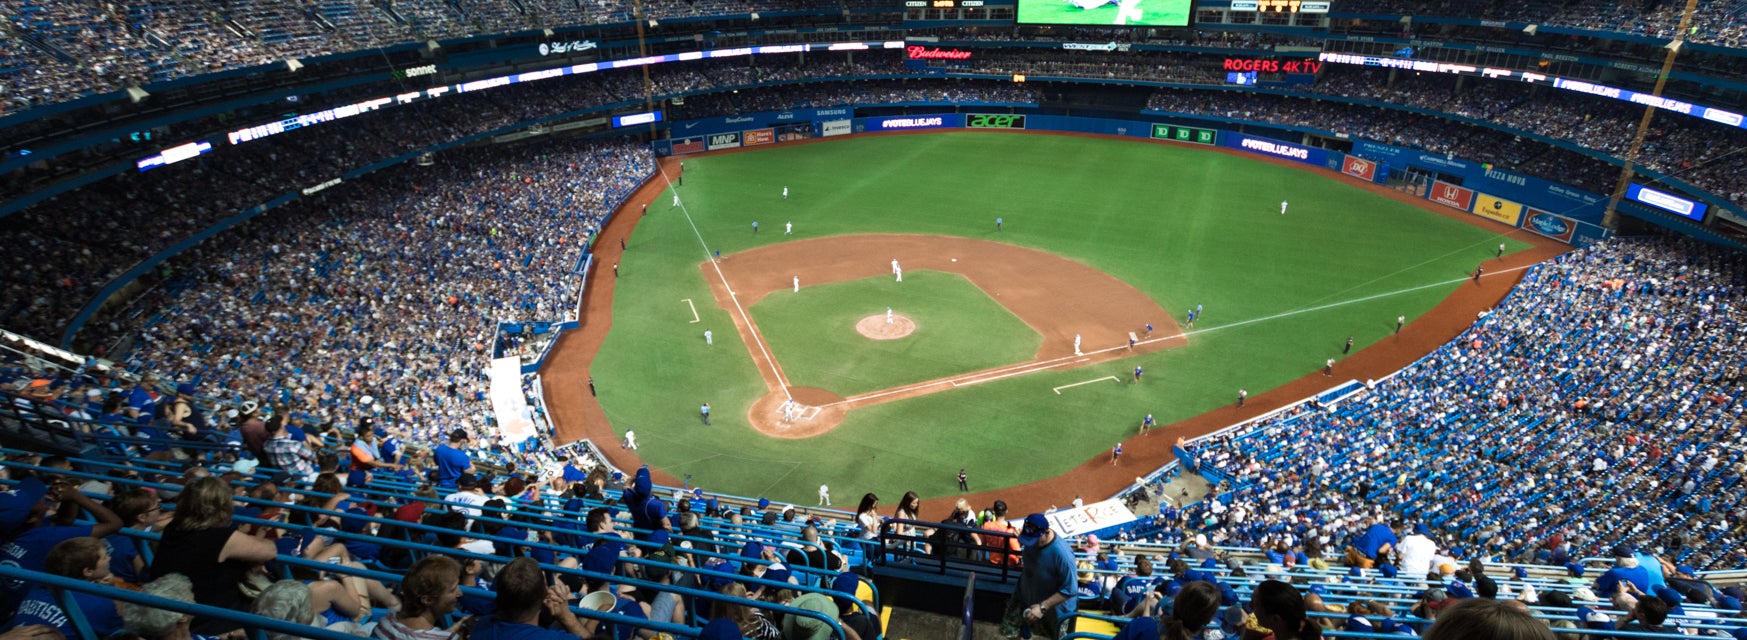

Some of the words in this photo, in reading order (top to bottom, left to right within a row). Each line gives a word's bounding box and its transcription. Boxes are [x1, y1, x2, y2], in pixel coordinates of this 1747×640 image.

[907, 45, 972, 59] Budweiser
[405, 64, 437, 77] sonnet
[1223, 58, 1279, 72] ROGERS
[1282, 61, 1300, 73] 4K
[1302, 61, 1322, 74] TV
[816, 108, 847, 116] SAMSUNG
[882, 117, 942, 128] #VOTEBLUEJAYS
[971, 115, 1020, 128] acer
[1157, 126, 1168, 136] TD
[1178, 129, 1189, 138] TD
[1200, 131, 1211, 141] TD
[712, 134, 735, 146] MNP
[1241, 138, 1308, 160] #VOTEBLUEJAYS
[1352, 162, 1365, 173] DQ
[1485, 169, 1505, 181] PIZZA
[1507, 174, 1526, 186] NOVA
[1437, 196, 1460, 208] HONDA
